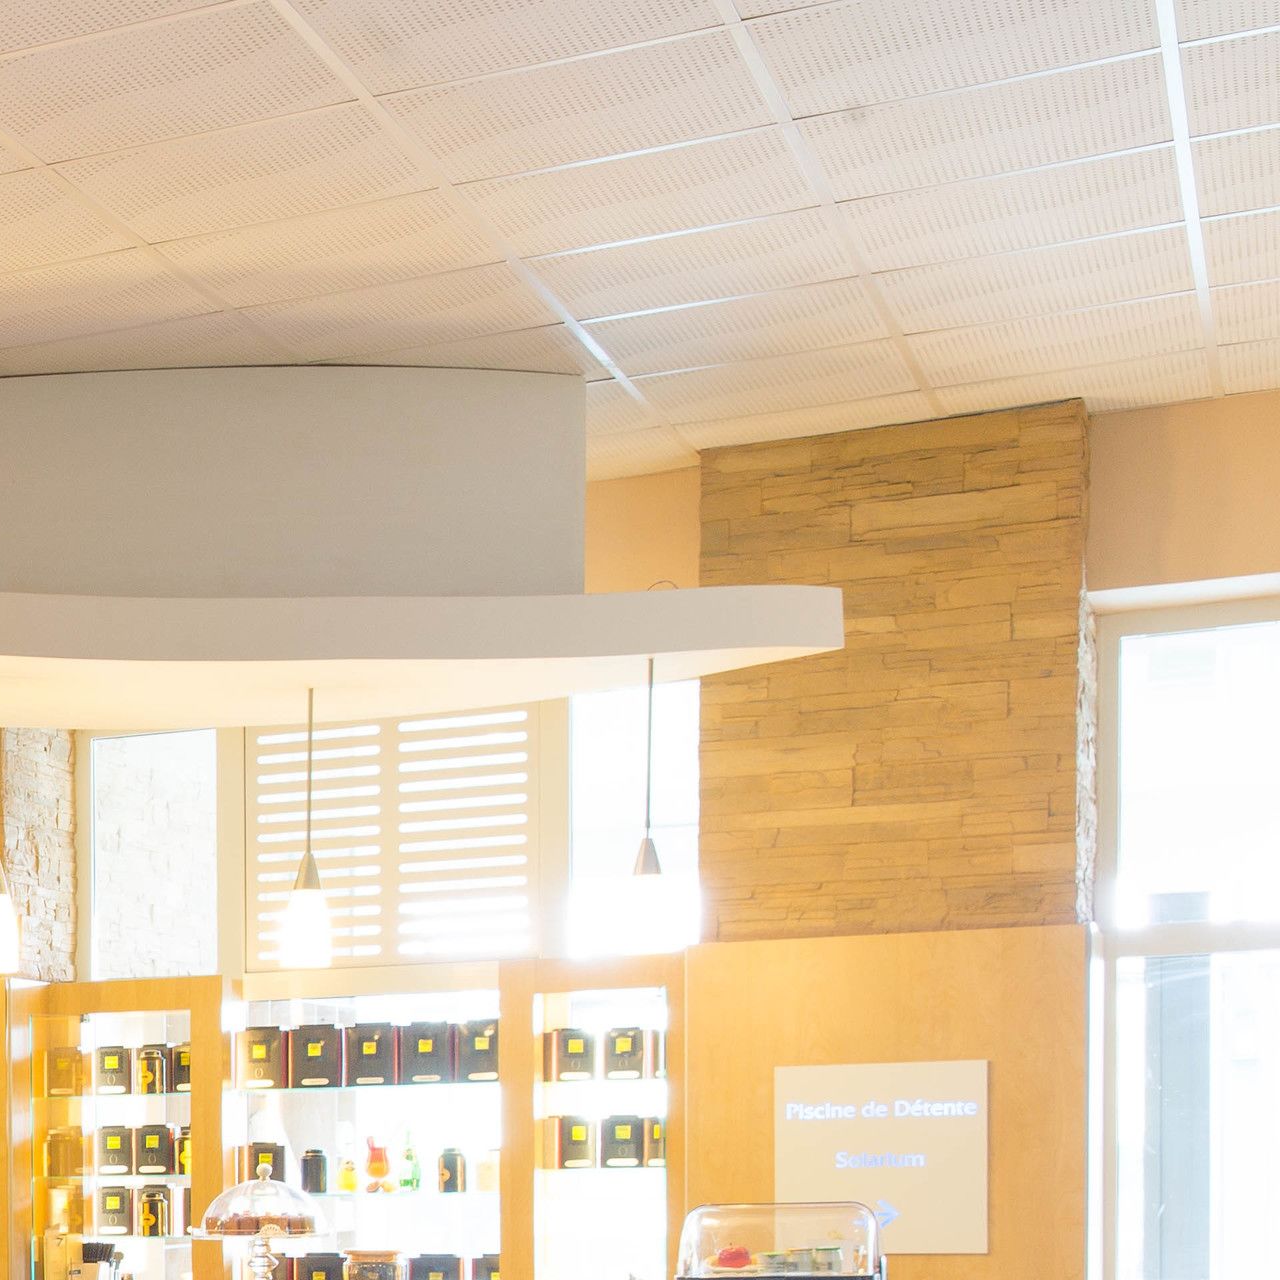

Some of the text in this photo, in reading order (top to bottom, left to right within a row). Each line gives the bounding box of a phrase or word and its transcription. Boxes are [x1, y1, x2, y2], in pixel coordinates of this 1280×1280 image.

[785, 1097, 978, 1121] Piscine de Détente
[834, 1150, 926, 1169] Solarium
